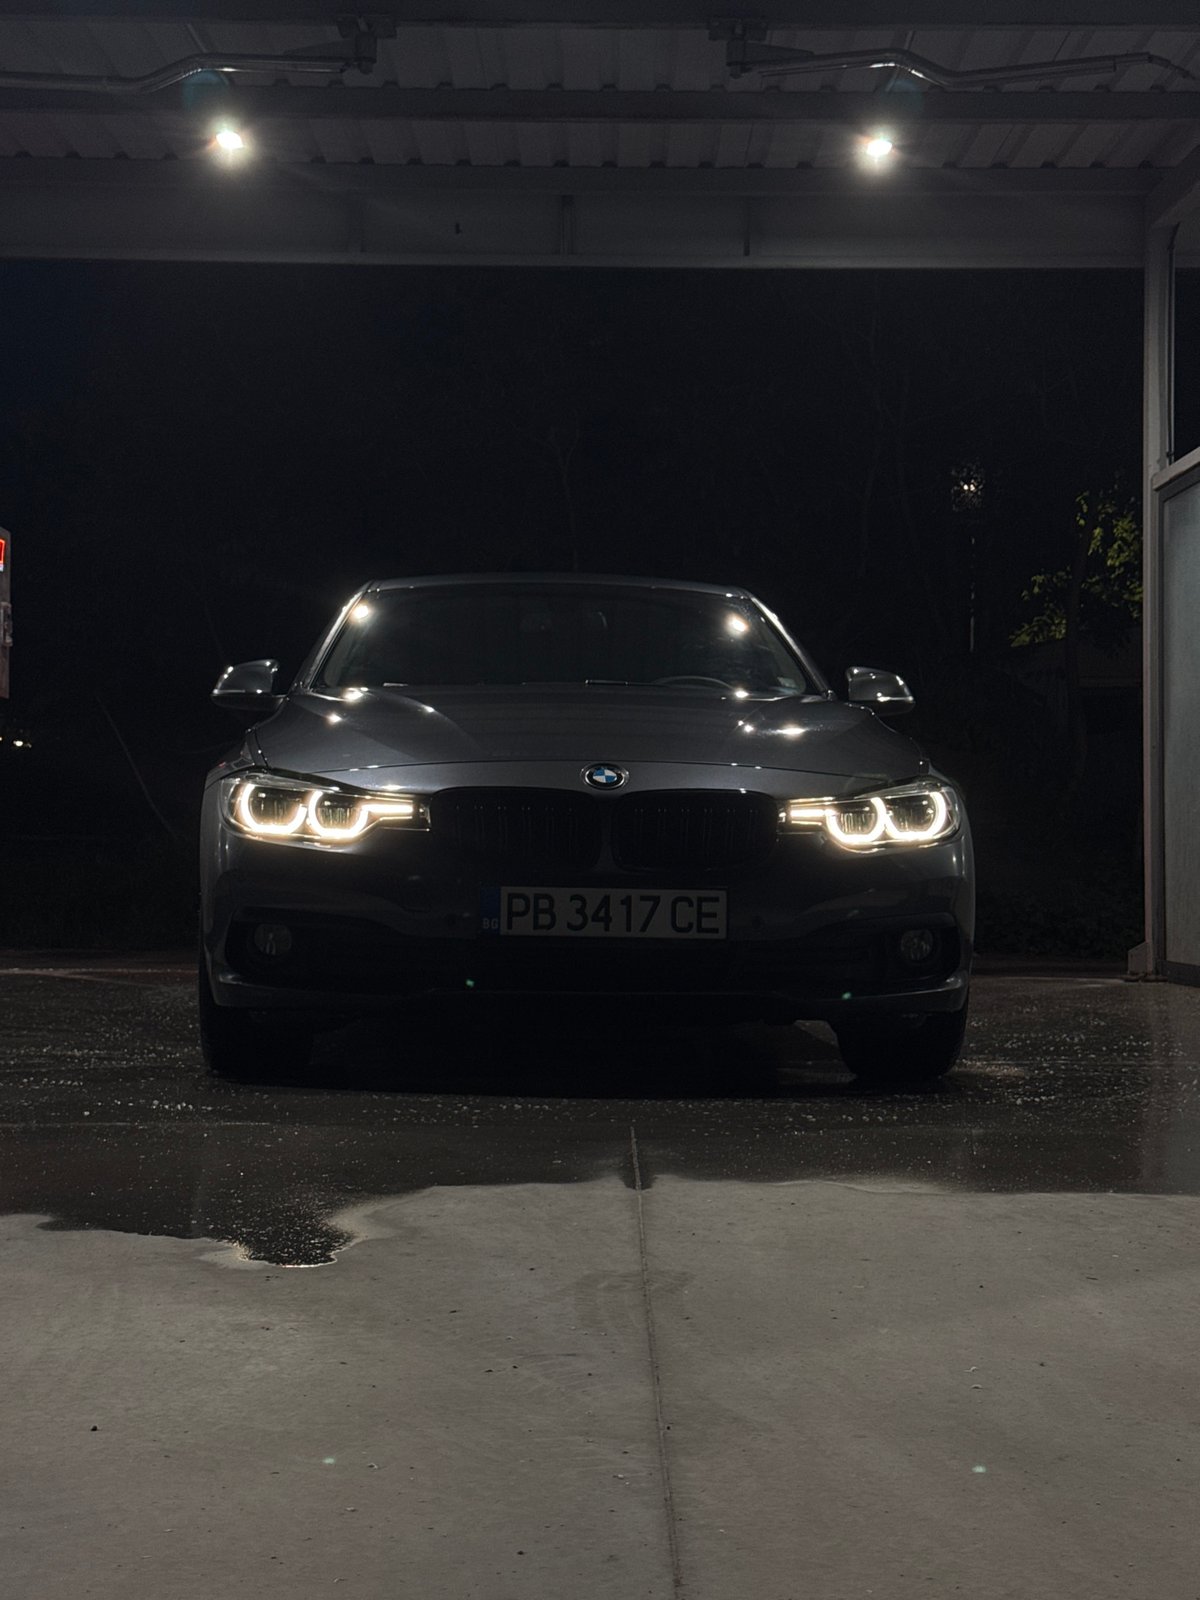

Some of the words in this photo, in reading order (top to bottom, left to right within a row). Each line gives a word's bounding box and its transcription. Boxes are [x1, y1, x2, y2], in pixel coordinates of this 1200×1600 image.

[481, 917, 499, 930] BG
[506, 892, 556, 931] PB
[566, 894, 661, 933] 3417
[671, 896, 720, 934] CE
